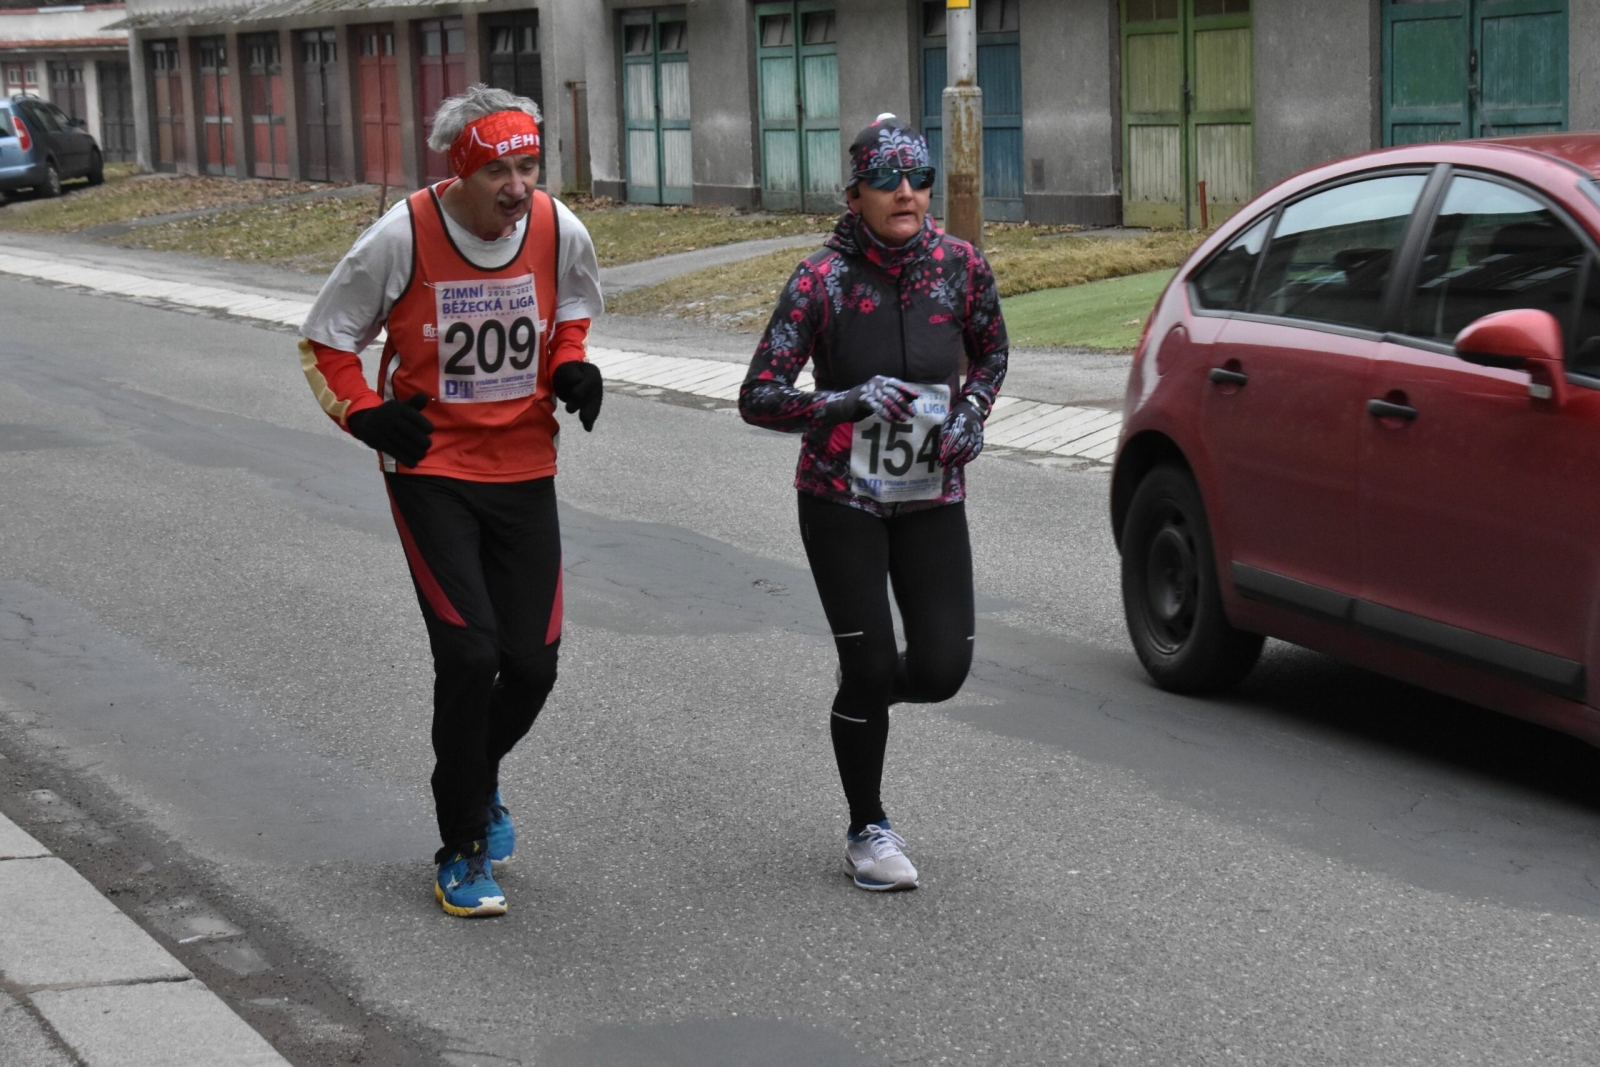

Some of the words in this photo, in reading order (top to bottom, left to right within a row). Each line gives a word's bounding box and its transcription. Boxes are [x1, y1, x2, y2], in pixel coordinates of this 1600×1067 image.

[442, 284, 484, 299] ZIMNÍ
[442, 297, 503, 314] BĚŽECKÁ
[509, 295, 535, 310] LIGA
[444, 316, 536, 375] 209
[923, 403, 947, 415] LIGA
[861, 422, 942, 477] 154
